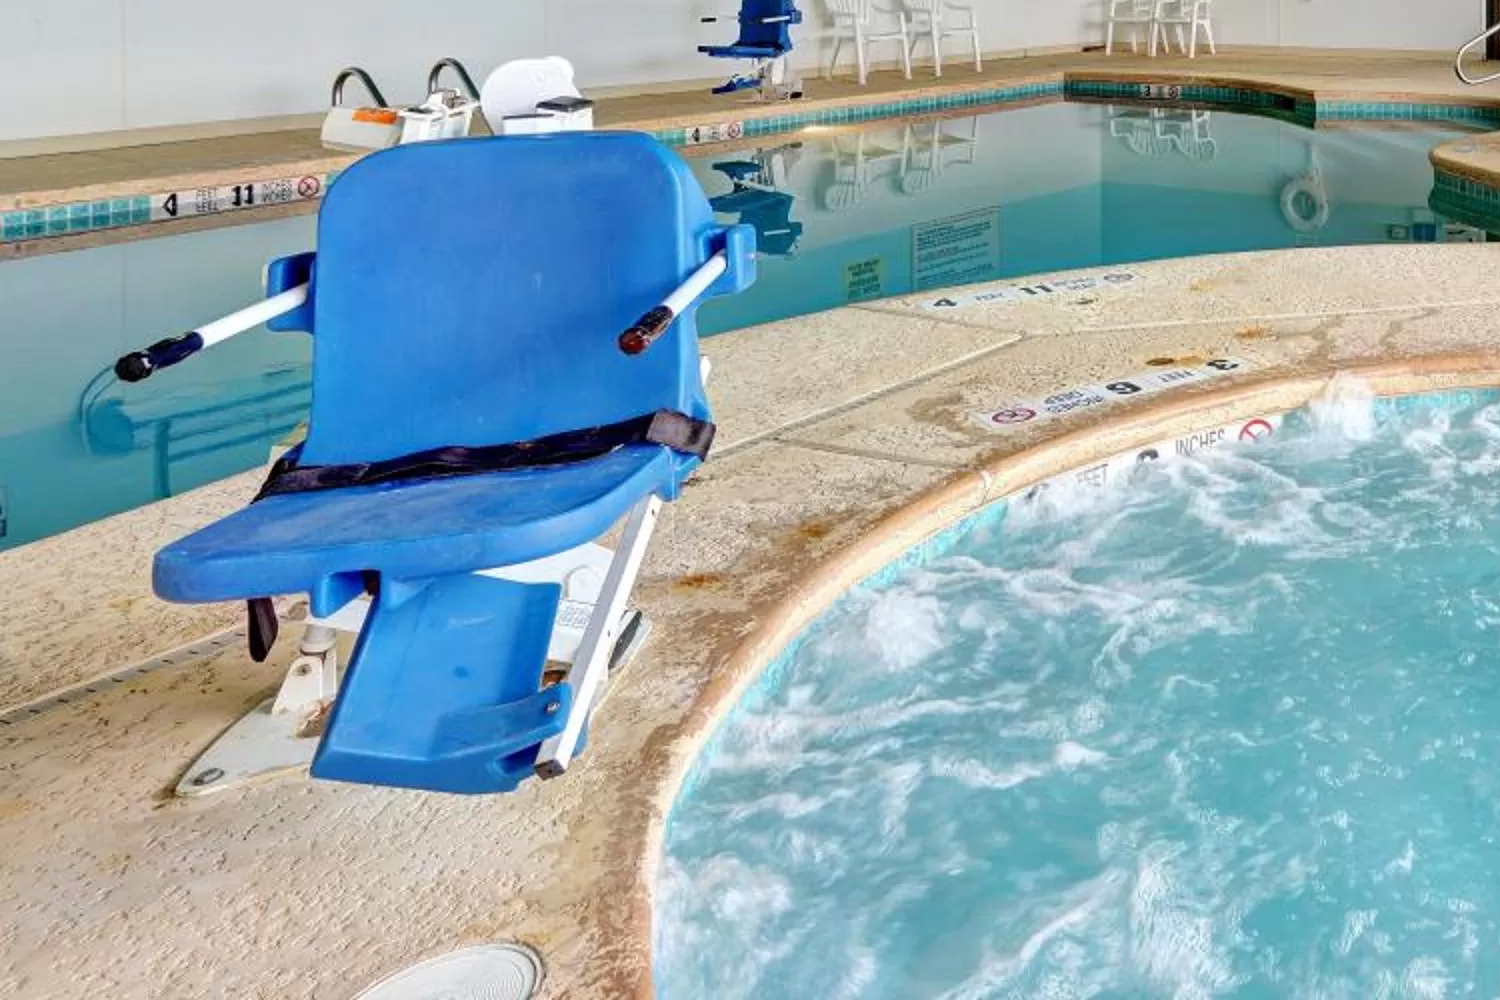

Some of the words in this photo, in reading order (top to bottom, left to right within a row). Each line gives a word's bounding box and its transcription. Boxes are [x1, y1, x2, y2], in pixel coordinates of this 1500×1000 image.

[231, 184, 254, 206] 11
[933, 298, 957, 307] 4
[1019, 284, 1053, 295] 11
[1207, 359, 1239, 371] 3
[1105, 381, 1142, 395] 6
